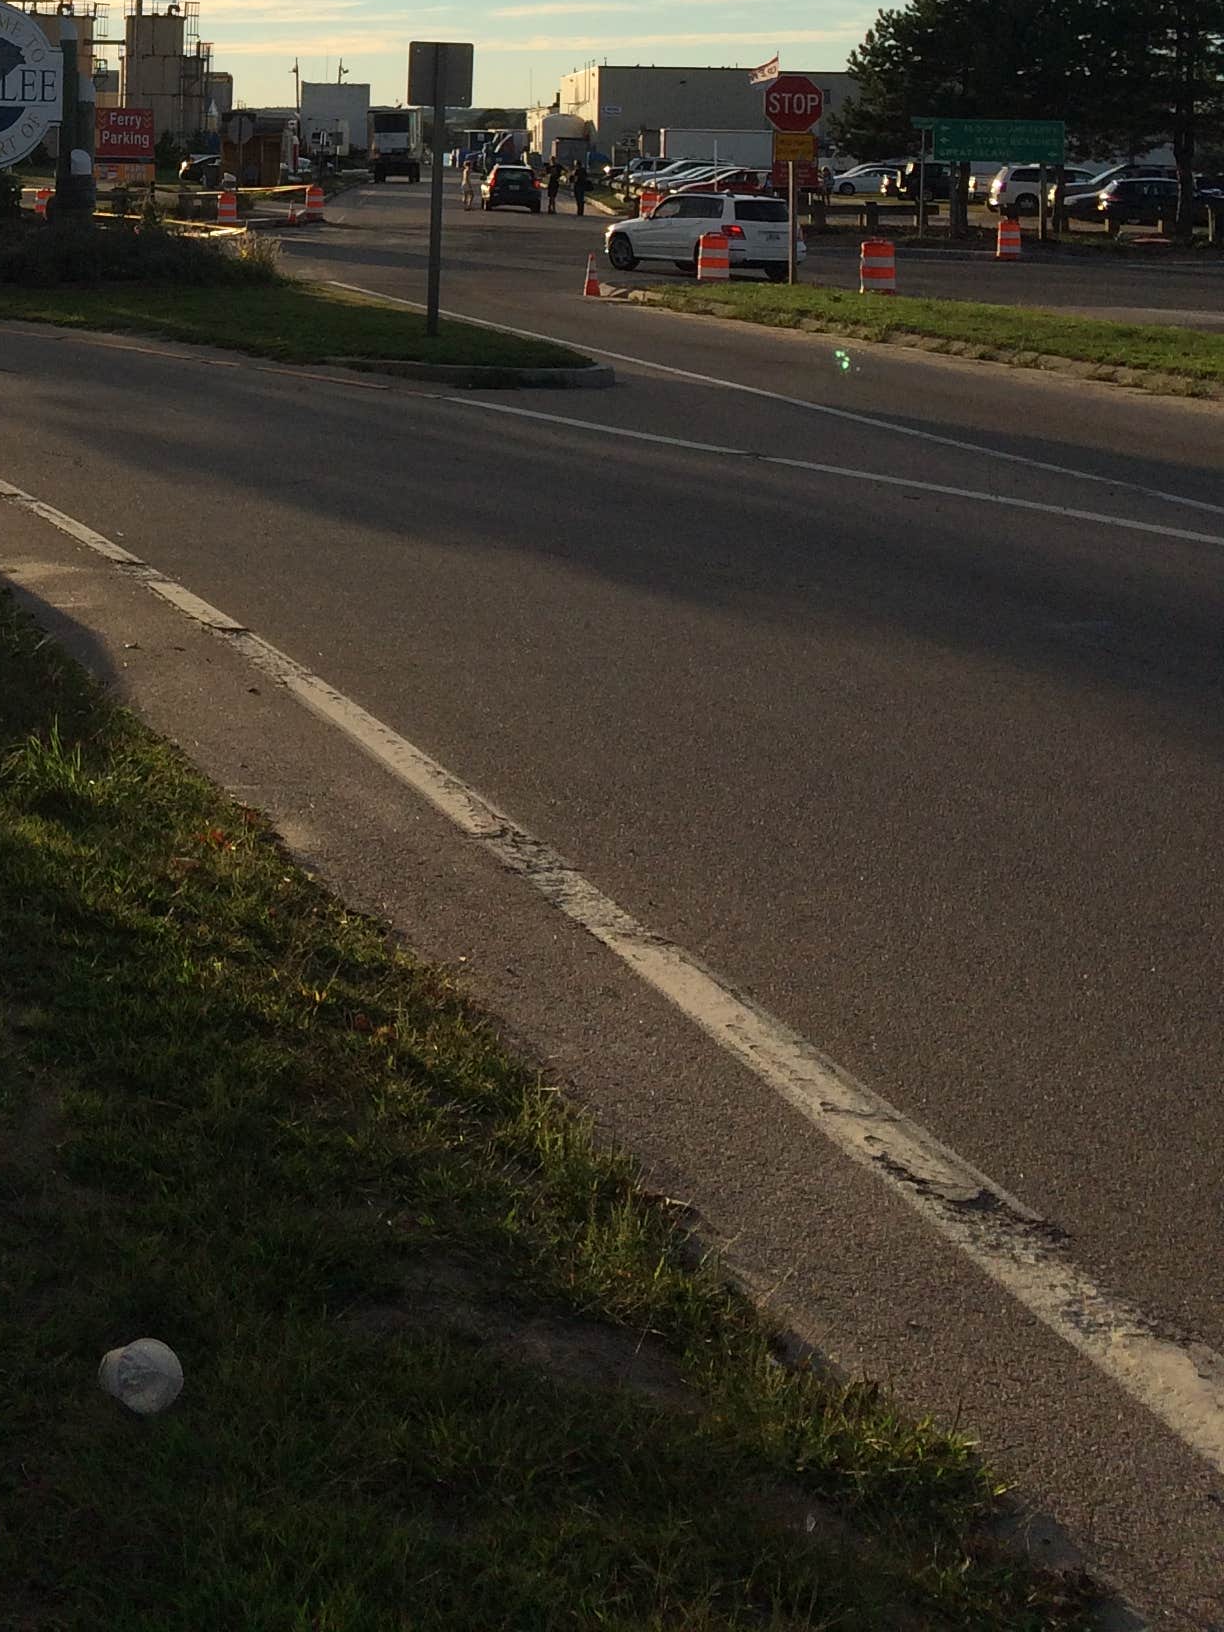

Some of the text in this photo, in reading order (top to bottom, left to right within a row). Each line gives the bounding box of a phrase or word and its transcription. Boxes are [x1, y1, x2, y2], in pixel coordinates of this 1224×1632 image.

[26, 38, 46, 64] TO
[768, 93, 819, 114] STOP
[20, 113, 42, 138] OF
[109, 112, 142, 129] Ferry
[102, 130, 150, 149] Parking
